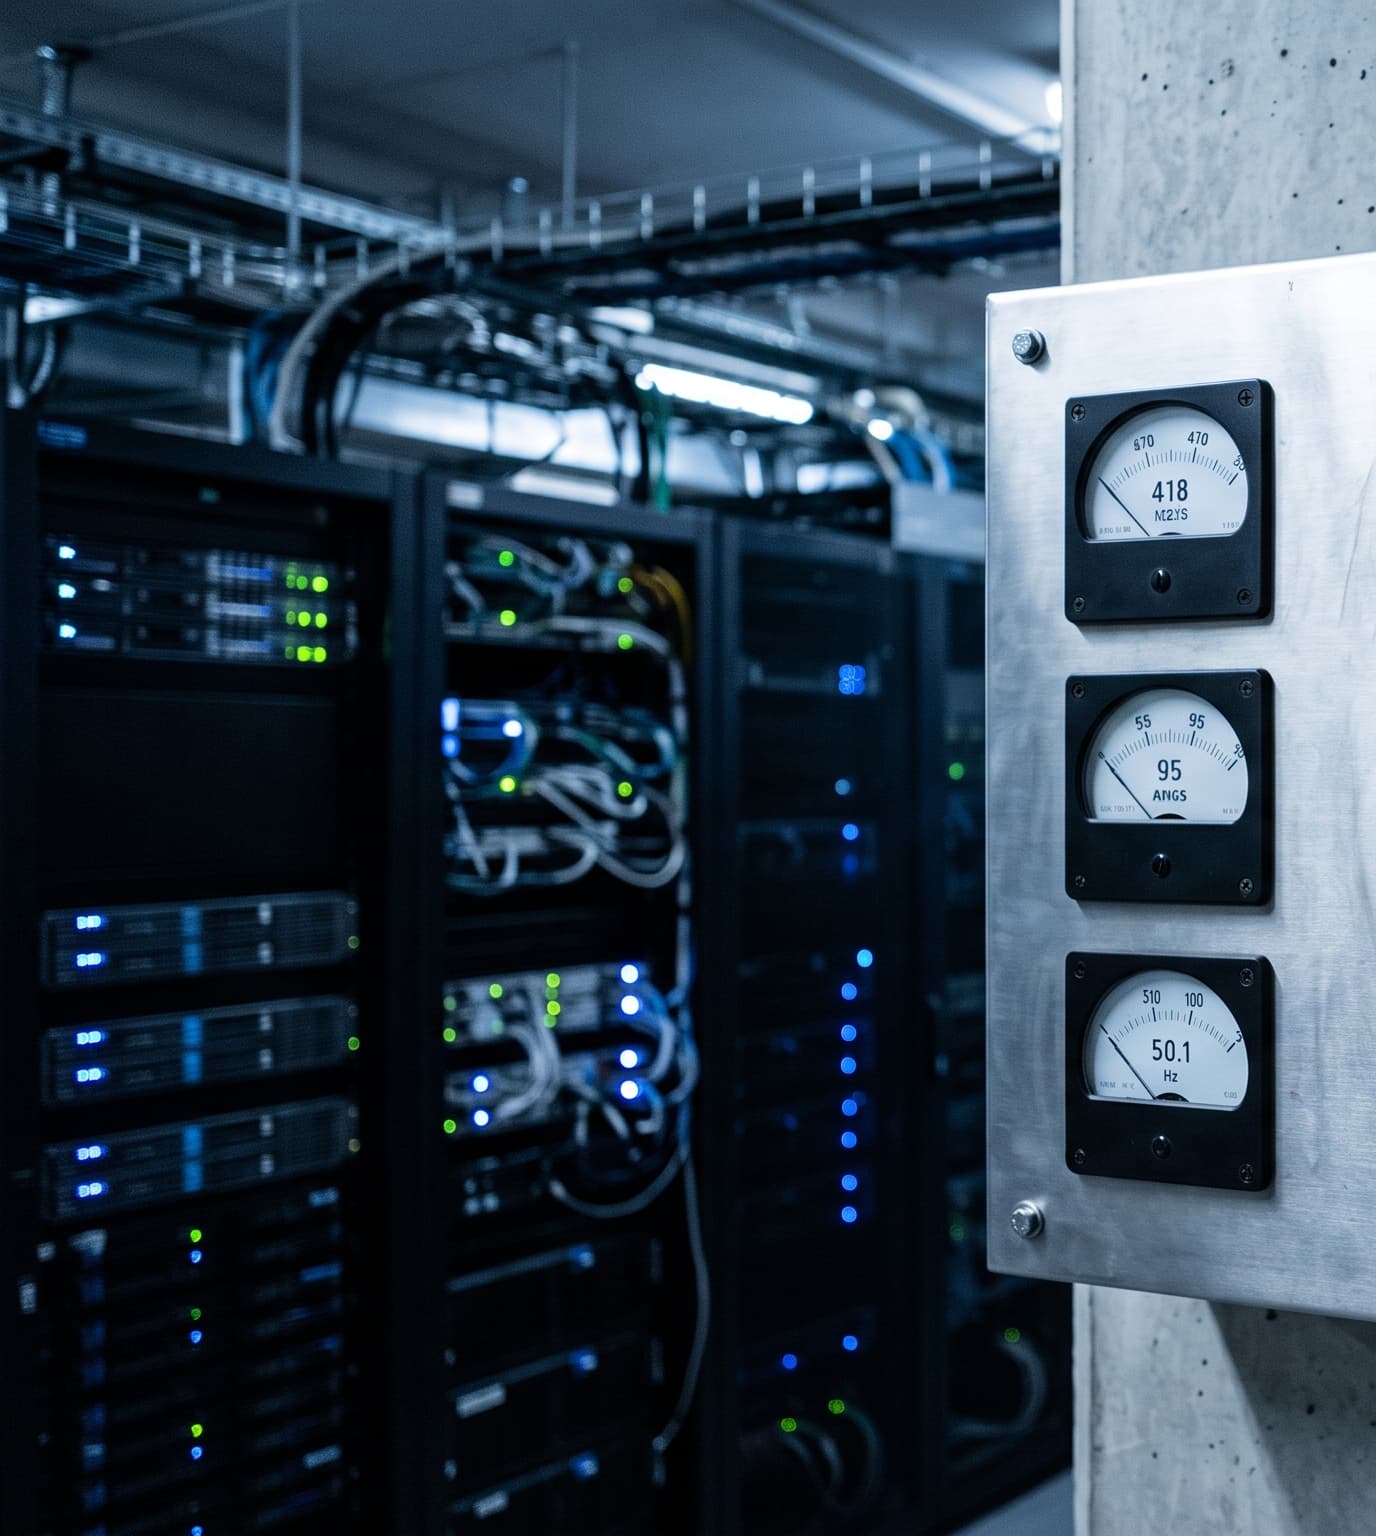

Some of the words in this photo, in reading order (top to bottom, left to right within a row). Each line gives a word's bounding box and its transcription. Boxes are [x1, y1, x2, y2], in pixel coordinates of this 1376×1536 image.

[1187, 431, 1209, 446] 470
[1151, 479, 1189, 502] 418
[1135, 714, 1152, 731] 55
[1189, 712, 1206, 729] 95
[1157, 759, 1182, 781] 95
[1152, 789, 1188, 802] ANGS
[1184, 992, 1204, 1008] 100
[1152, 1038, 1191, 1063] 50.1
[1163, 1069, 1179, 1083] Hz
